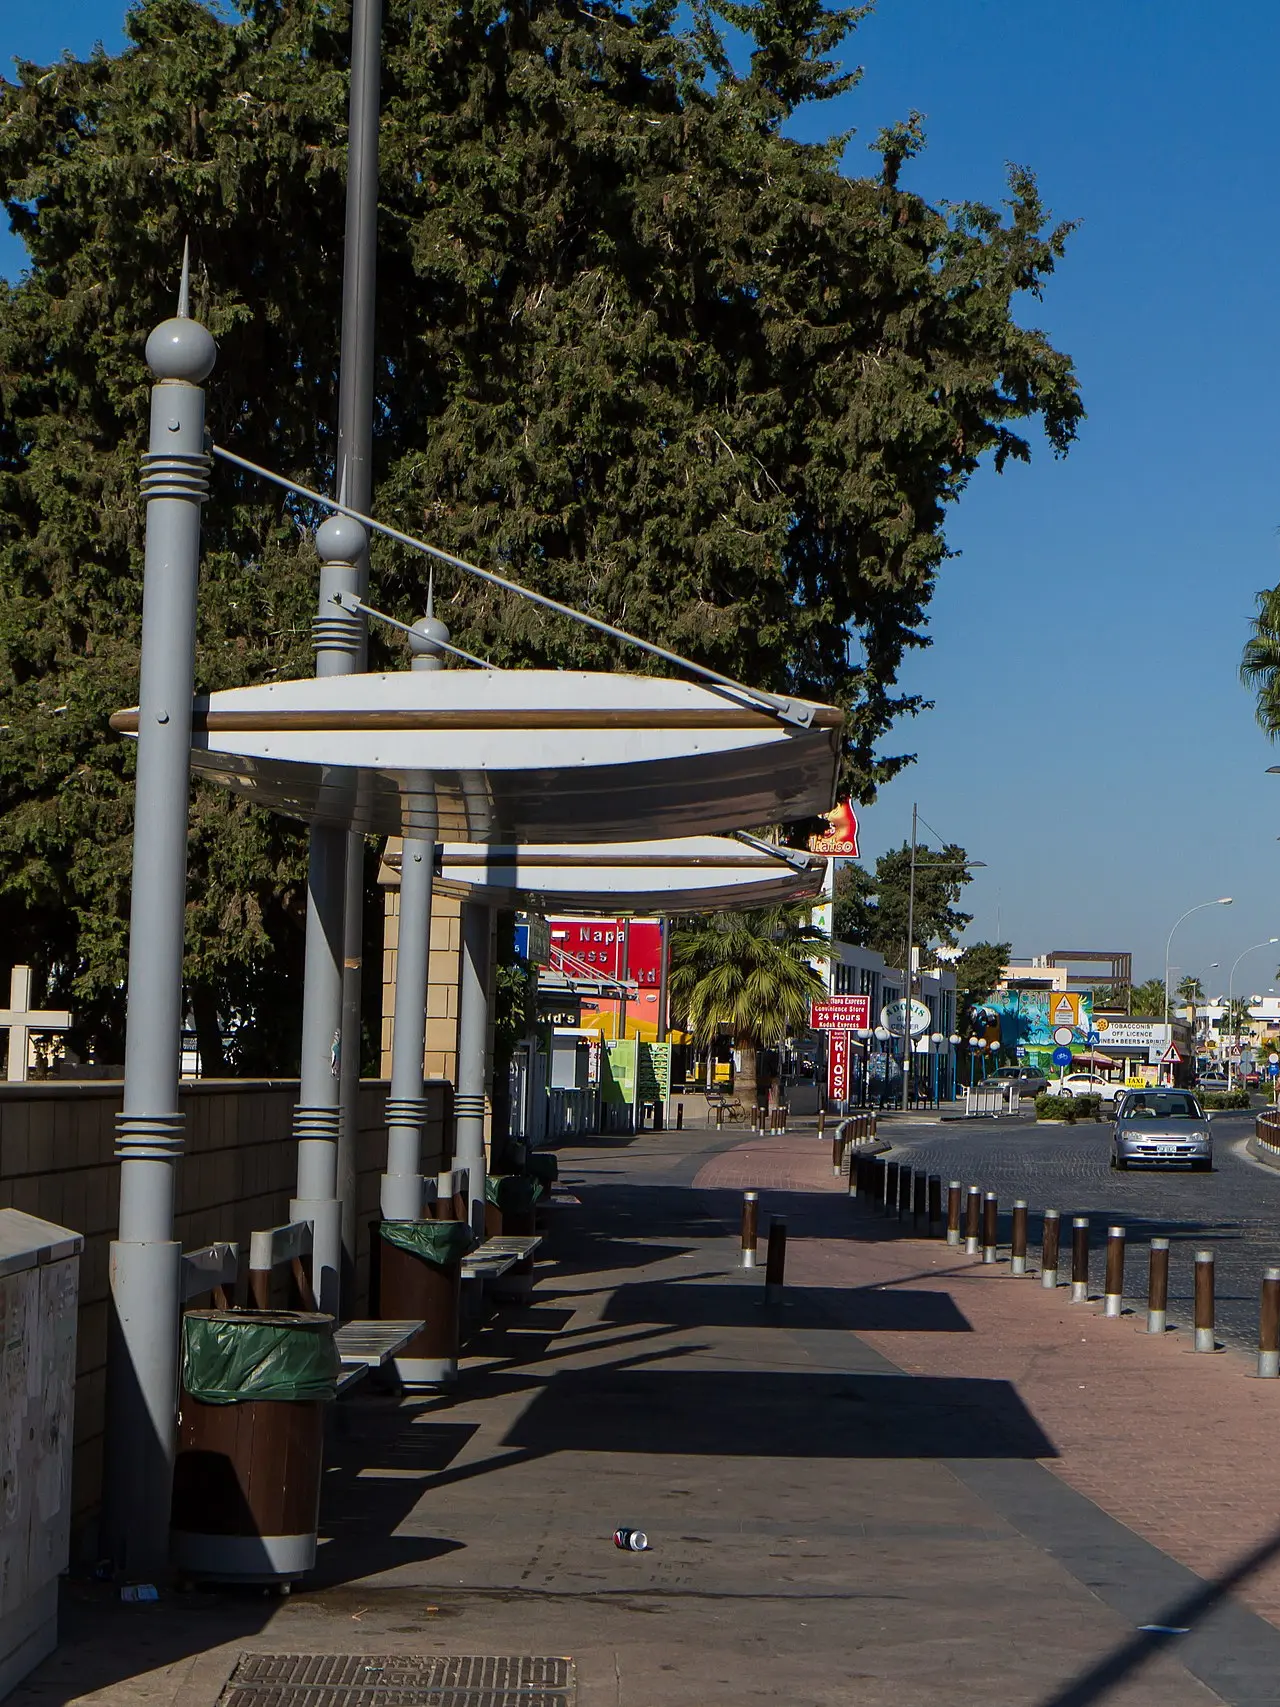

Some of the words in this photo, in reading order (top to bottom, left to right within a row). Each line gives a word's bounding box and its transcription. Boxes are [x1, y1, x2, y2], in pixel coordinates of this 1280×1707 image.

[818, 1012, 830, 1021] 24
[833, 1012, 861, 1021] Hours
[833, 1041, 844, 1098] KIOSK
